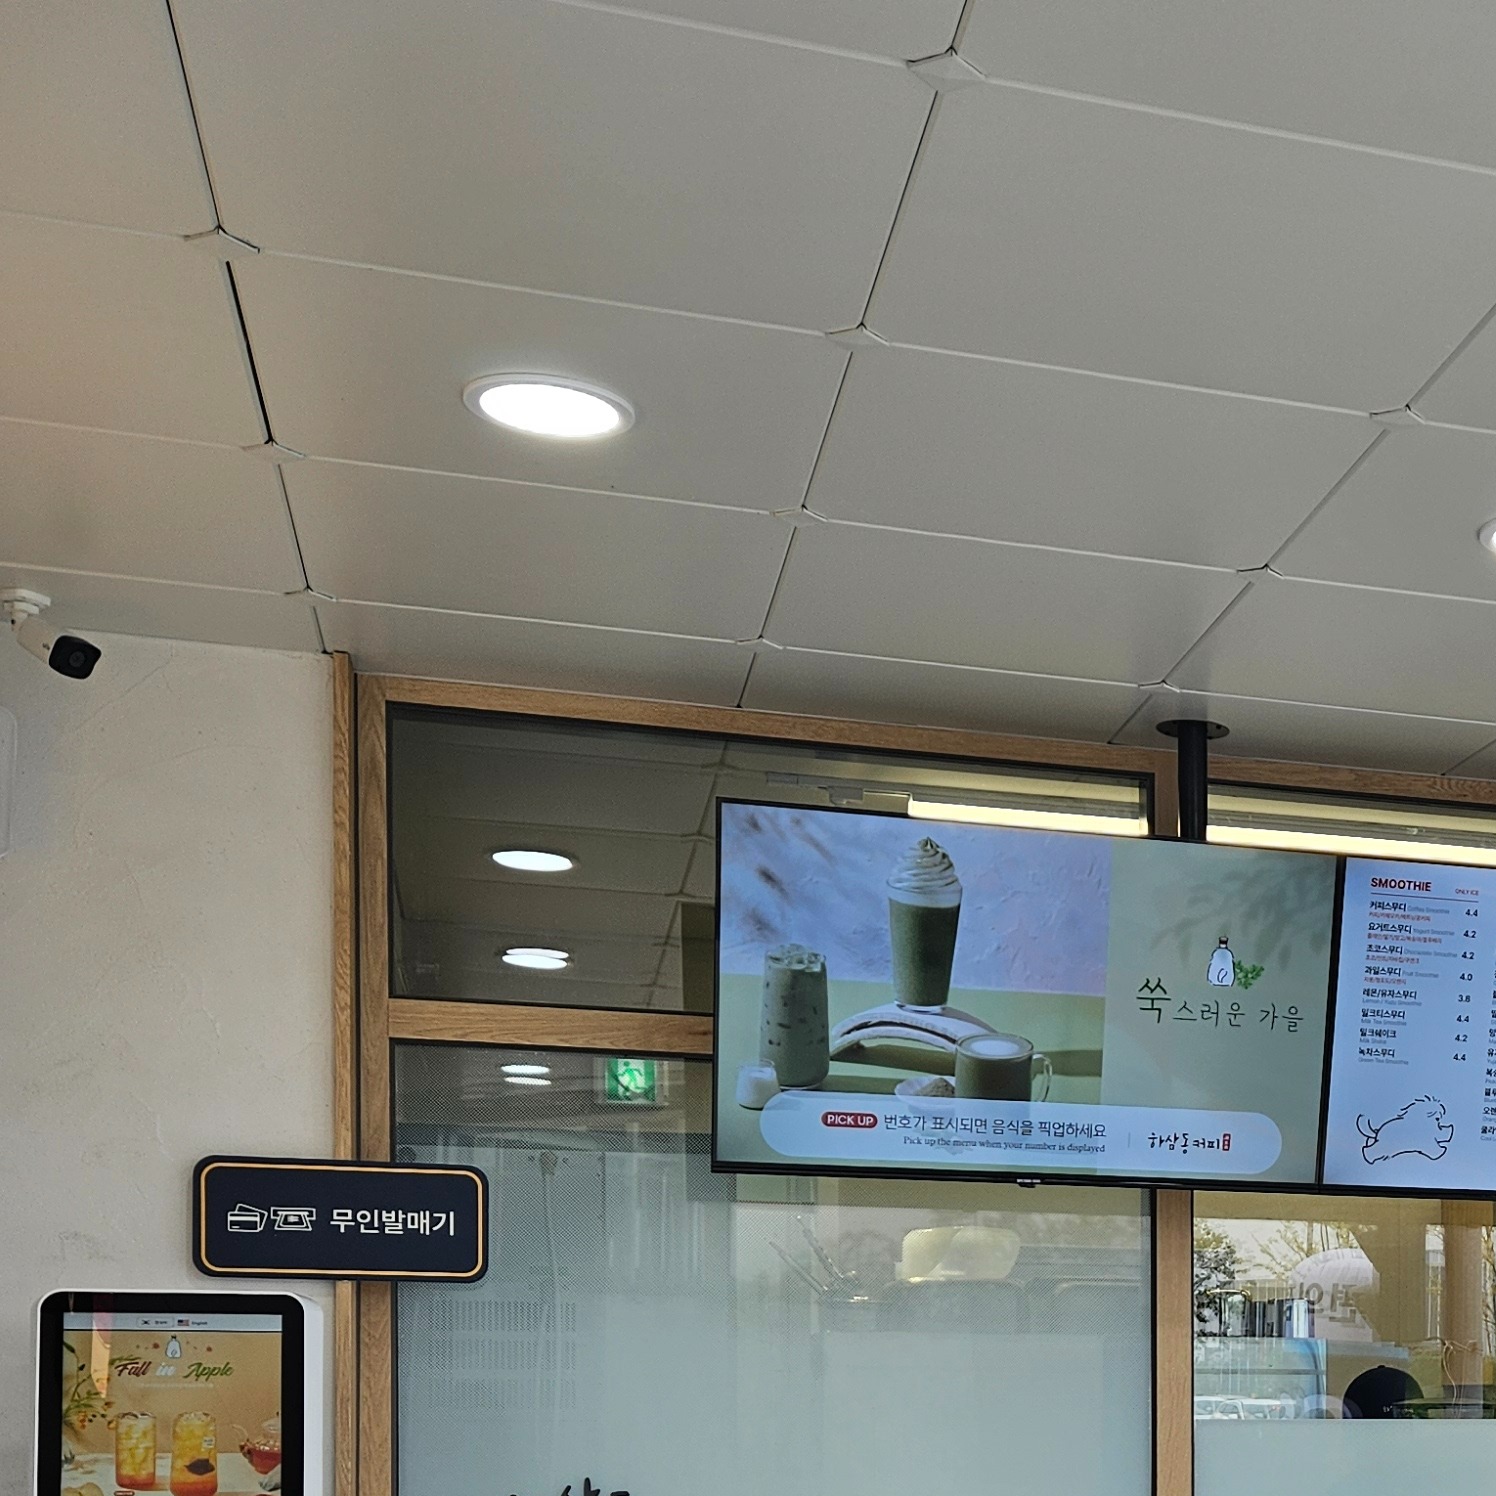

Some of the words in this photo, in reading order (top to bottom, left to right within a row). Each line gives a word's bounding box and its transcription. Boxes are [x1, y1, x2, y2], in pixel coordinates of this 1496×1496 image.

[1371, 877, 1432, 891] SMOOTHIE
[1465, 909, 1478, 917] 4.4
[1463, 930, 1477, 938] 4.2
[1460, 973, 1473, 981] 4.0
[1259, 1003, 1304, 1032] 가을
[827, 1115, 855, 1125] PICK
[857, 1116, 874, 1126] UP
[884, 1114, 927, 1131] 번호가
[931, 1117, 989, 1135] 표시되면
[992, 1119, 1034, 1136] 음식을
[1038, 1121, 1107, 1139] 픽업하세요
[904, 1136, 922, 1145] Pick
[925, 1137, 935, 1146] up
[938, 1137, 950, 1146] the
[1004, 1141, 1023, 1150] your
[1067, 1143, 1105, 1153] displayed
[1148, 1132, 1220, 1154] 하삼동커피
[330, 1209, 455, 1236] 무인발매기
[114, 1361, 152, 1377] Fall
[182, 1362, 235, 1382] Apple
